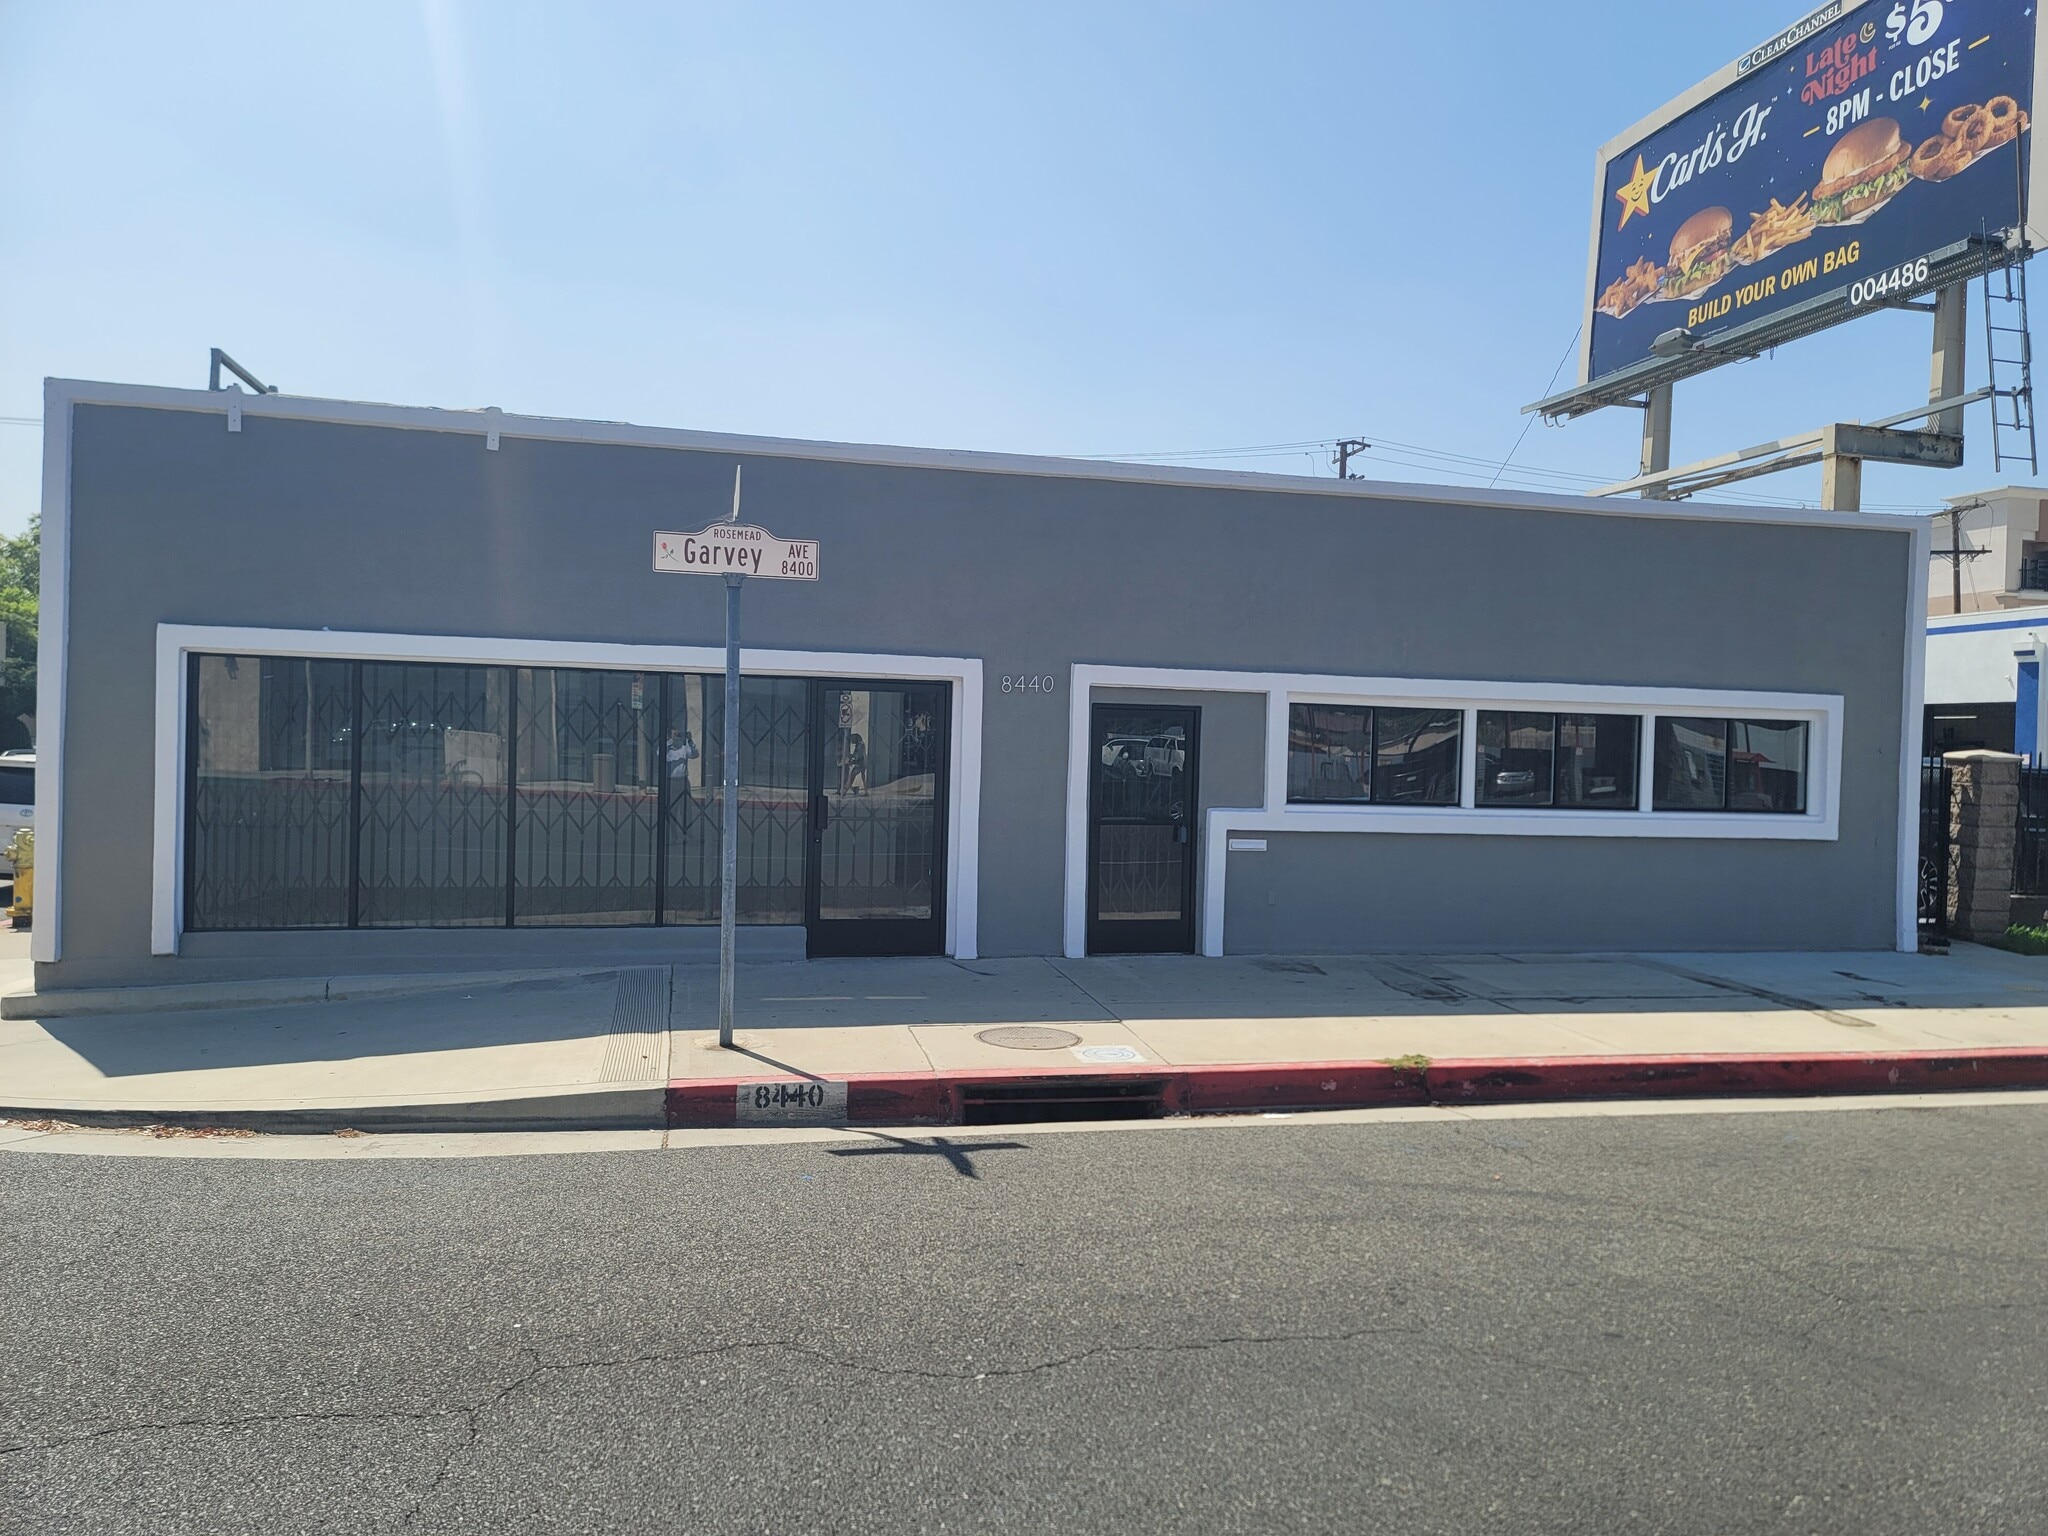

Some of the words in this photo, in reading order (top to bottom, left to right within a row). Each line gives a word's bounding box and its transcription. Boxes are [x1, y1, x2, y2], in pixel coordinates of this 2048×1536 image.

[1801, 46, 1878, 106] Night
[1805, 32, 1857, 78] Late
[1825, 87, 1870, 136] 8PM
[1889, 37, 1961, 102] CLOSE
[1650, 122, 1727, 204] Carl's
[1726, 102, 1772, 163] Jr.
[1687, 294, 1731, 328] BUILD
[1735, 275, 1776, 308] YOUR
[1780, 256, 1817, 290] OWN
[1822, 240, 1860, 274] BAG
[1850, 257, 1928, 306] 004486
[684, 538, 762, 574] Garvey
[788, 544, 809, 559] AVE
[713, 528, 762, 541] ROSEMEAD
[781, 561, 814, 576] 8400
[1001, 675, 1055, 693] 8440
[755, 1084, 824, 1108] 8440
